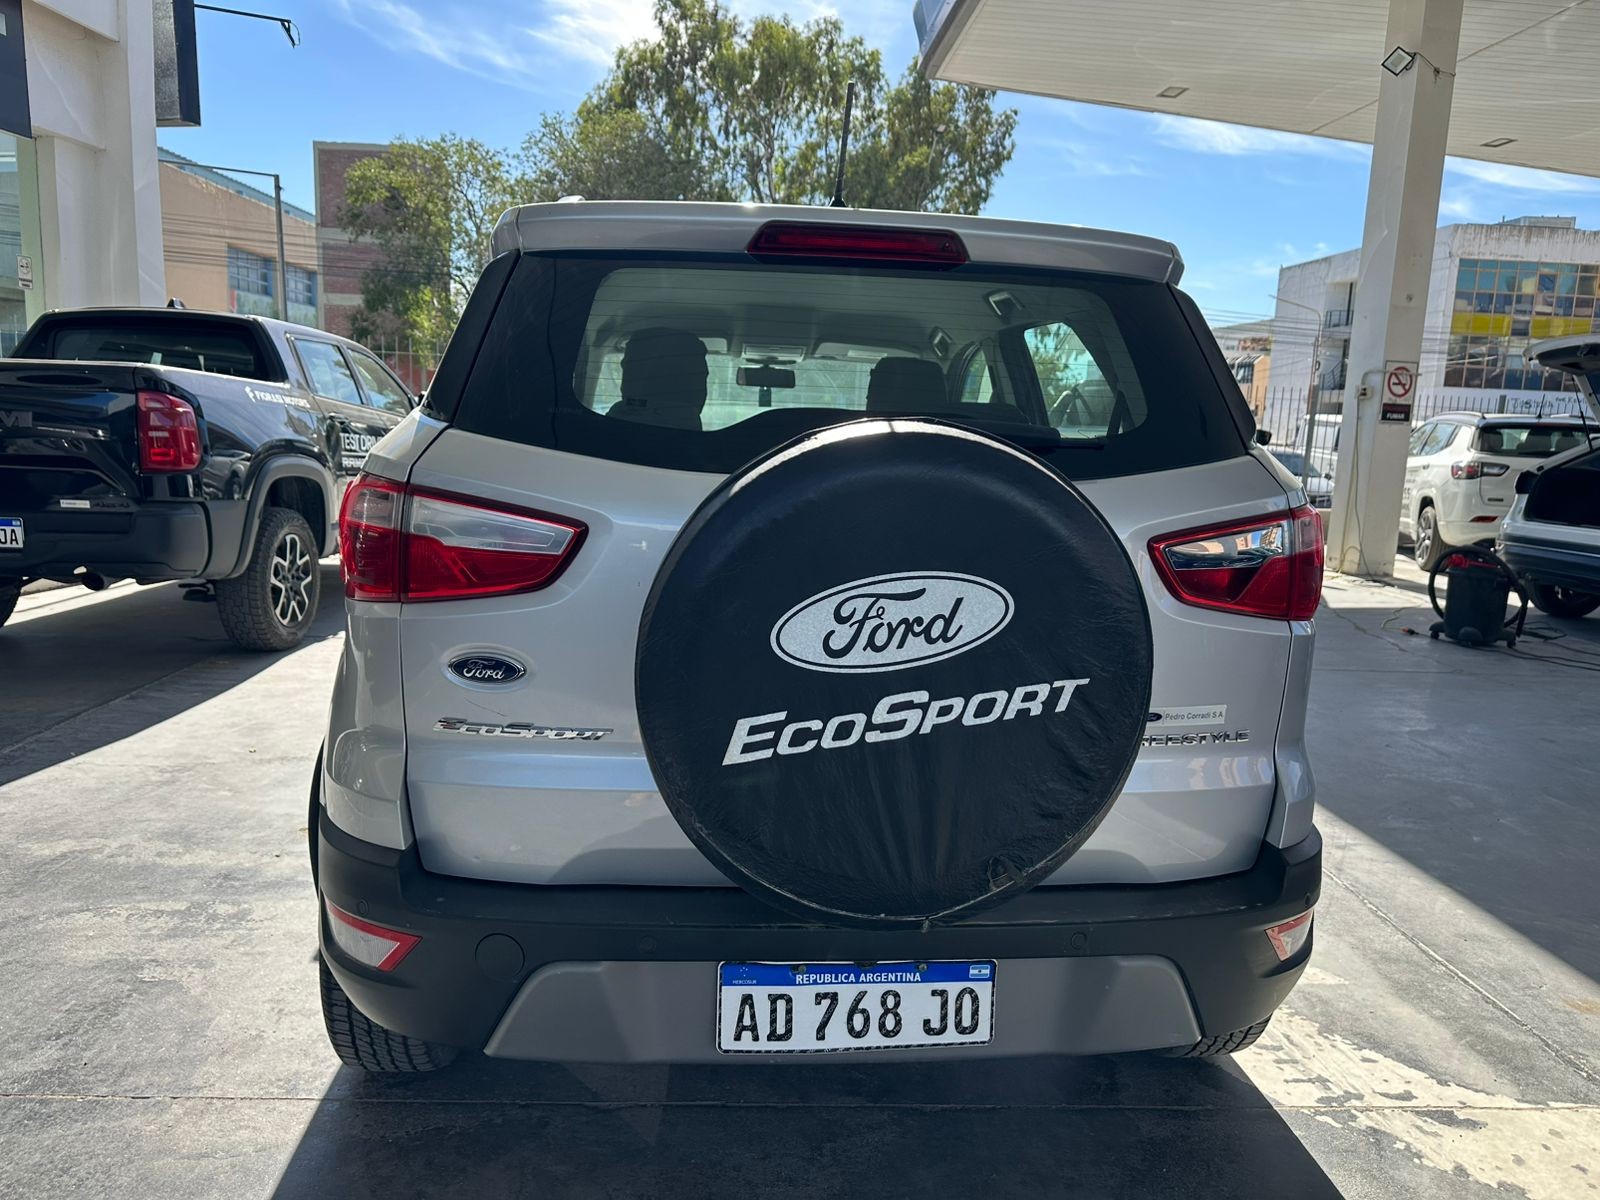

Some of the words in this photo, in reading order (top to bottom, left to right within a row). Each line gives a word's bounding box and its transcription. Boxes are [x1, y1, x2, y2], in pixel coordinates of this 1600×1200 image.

[339, 432, 361, 451] TEST
[822, 587, 964, 659] Ford
[463, 659, 505, 680] Ford
[1165, 713, 1186, 721] Pedro
[1186, 711, 1210, 720] Corradi
[1141, 729, 1250, 747] REESTYLE
[796, 974, 856, 985] REPUBLICA
[858, 972, 921, 983] ARGENTINA
[733, 993, 793, 1042] AD
[814, 989, 902, 1041] 768
